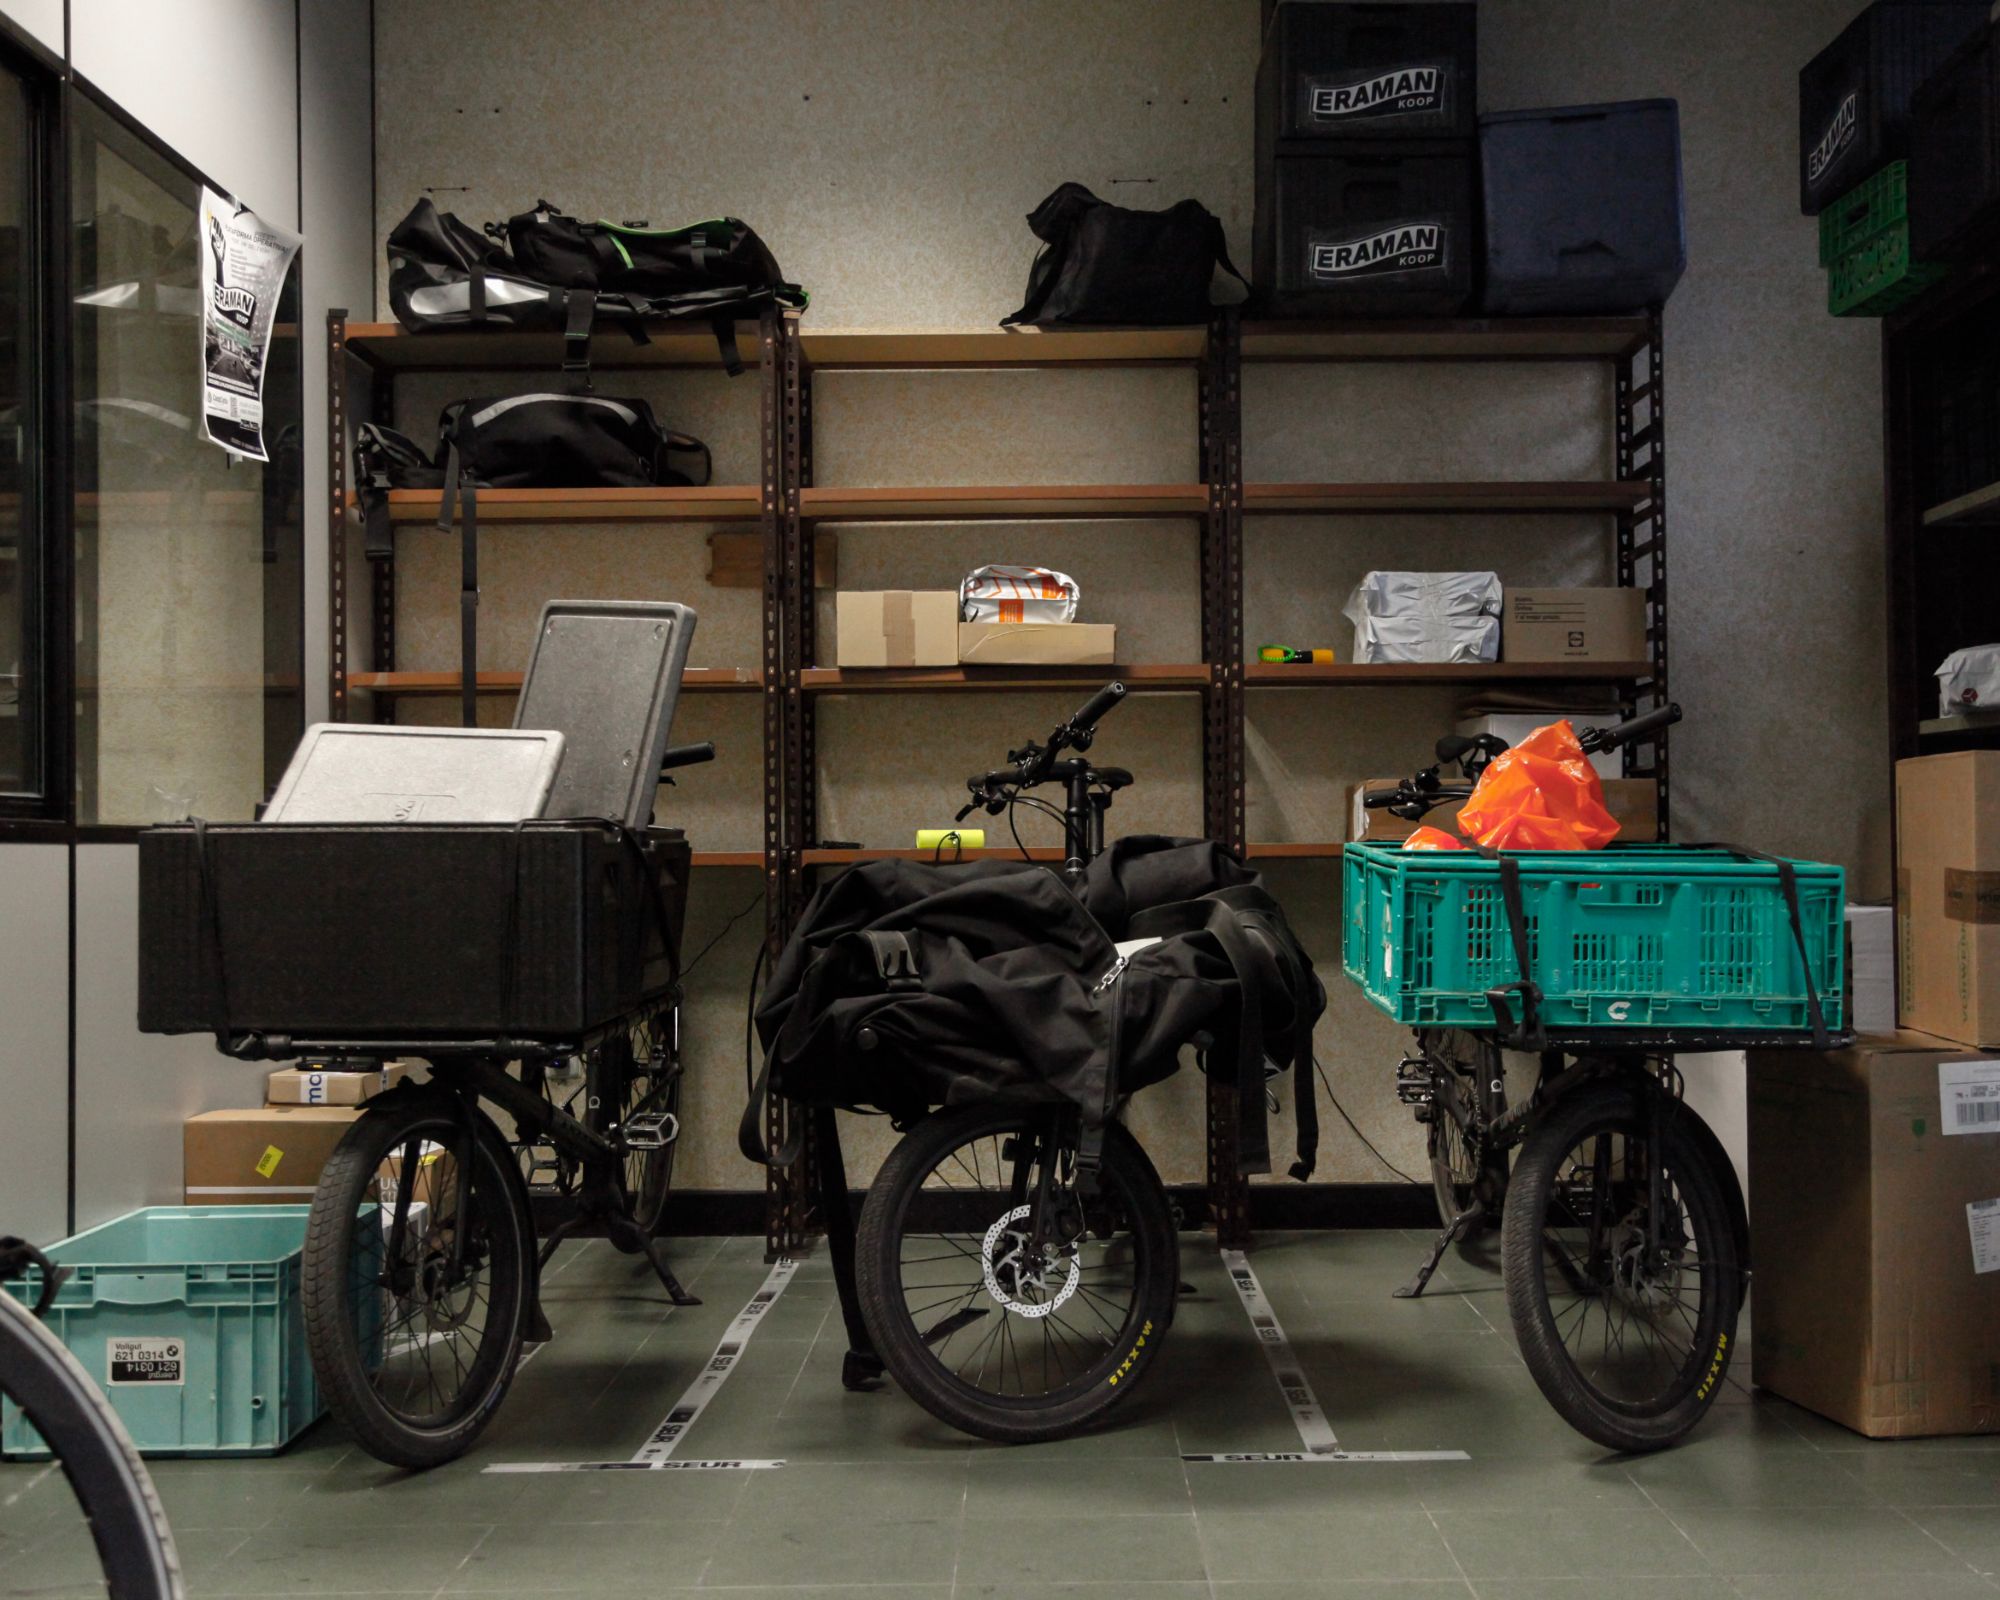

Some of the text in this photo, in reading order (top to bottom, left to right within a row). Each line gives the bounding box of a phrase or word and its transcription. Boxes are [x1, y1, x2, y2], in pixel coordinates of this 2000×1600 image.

[1315, 70, 1434, 111] ERAMAN
[1398, 96, 1434, 109] KOOP
[1810, 96, 1854, 178] ERAMAN
[1316, 228, 1435, 268] ERAMAN
[1399, 253, 1435, 266] KOOP
[215, 284, 253, 312] ERAMAN
[115, 1351, 165, 1361] 621 0314
[127, 1361, 177, 1372] 621 0314
[1109, 1320, 1153, 1386] MAXXIS
[1697, 1332, 1727, 1400] MAXXIS
[662, 1461, 742, 1469] SEUR
